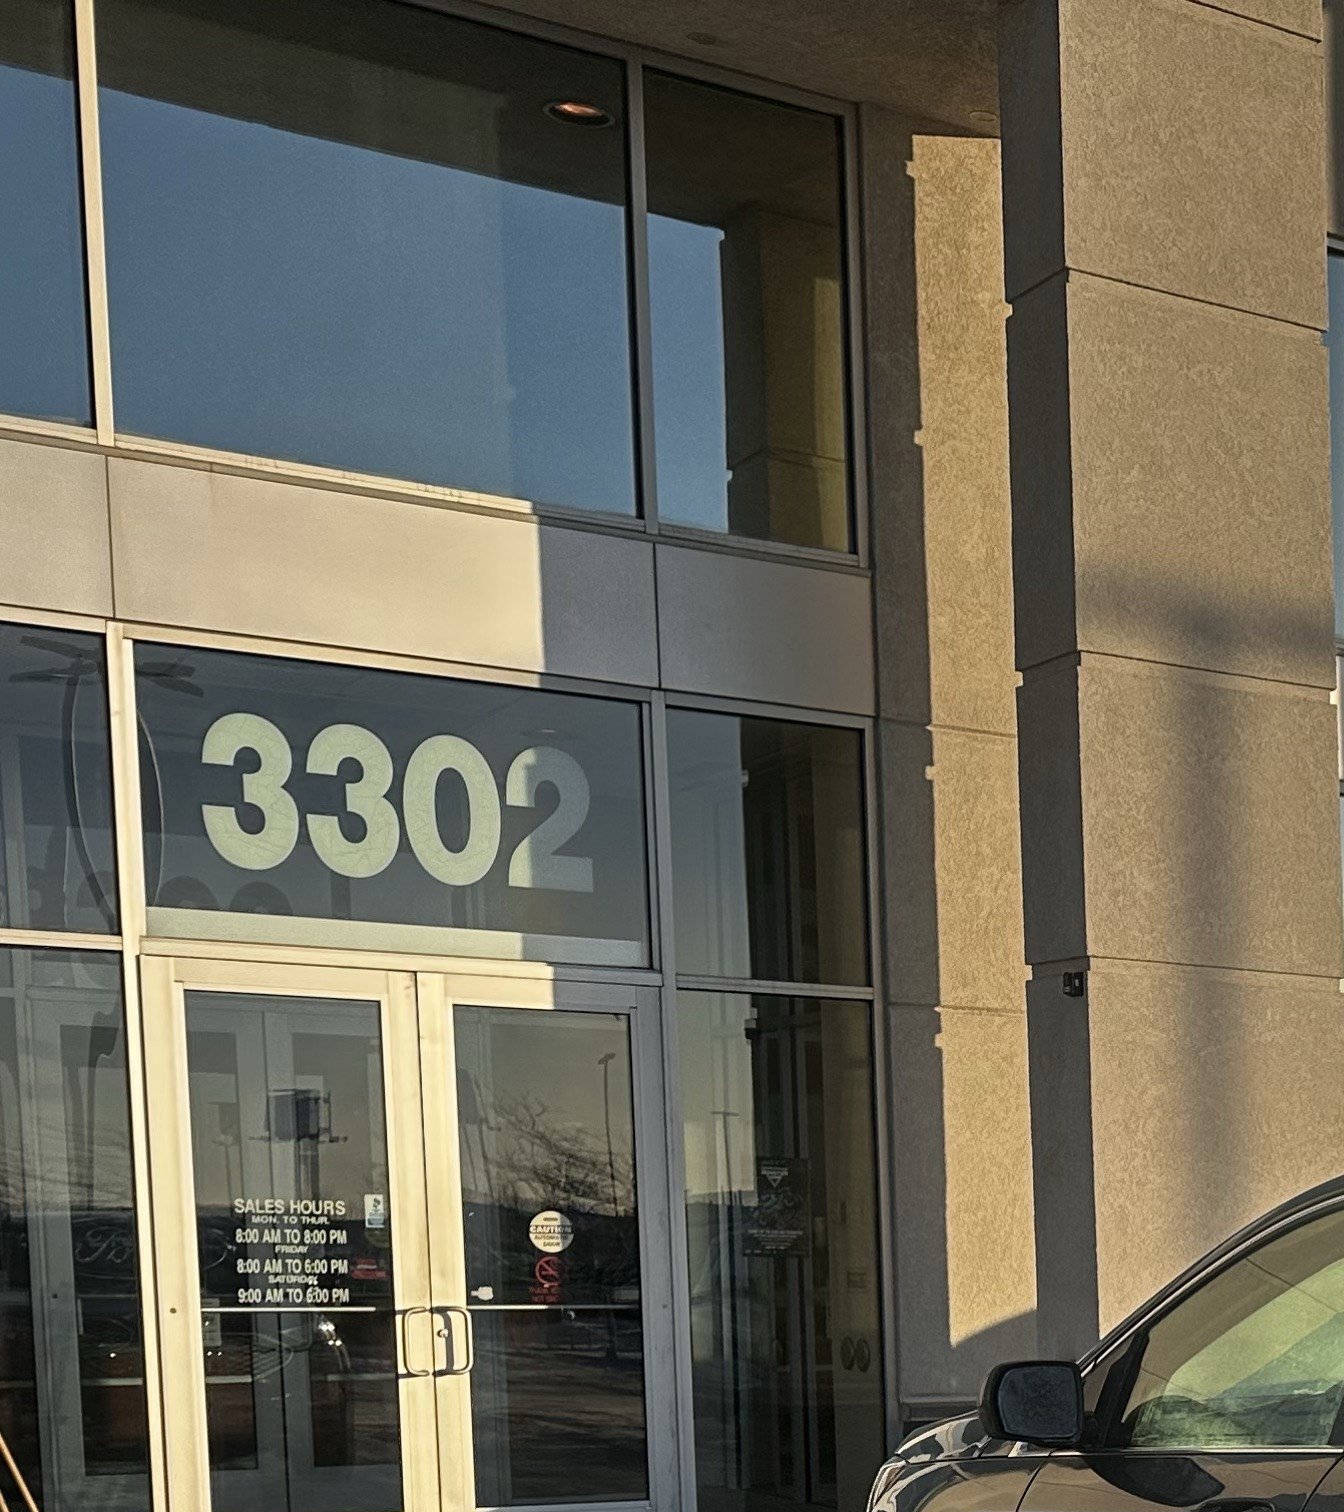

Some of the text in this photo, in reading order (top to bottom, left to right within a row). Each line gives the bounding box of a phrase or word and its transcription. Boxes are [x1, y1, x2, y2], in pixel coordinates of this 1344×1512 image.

[201, 712, 595, 893] 3302
[234, 1198, 346, 1216] SALES HOURS
[251, 1215, 330, 1225] MON. TO THUR.
[235, 1228, 348, 1245] 8:00 AM TO 8:00 PM
[530, 1225, 572, 1234] CAUTION
[275, 1245, 309, 1254] FRIDAY
[236, 1258, 348, 1274] 8:00 AM TO 6:00 PM
[268, 1275, 318, 1284] SATURDAY
[238, 1287, 350, 1304] 9:00 AM TO 6:00 PM
